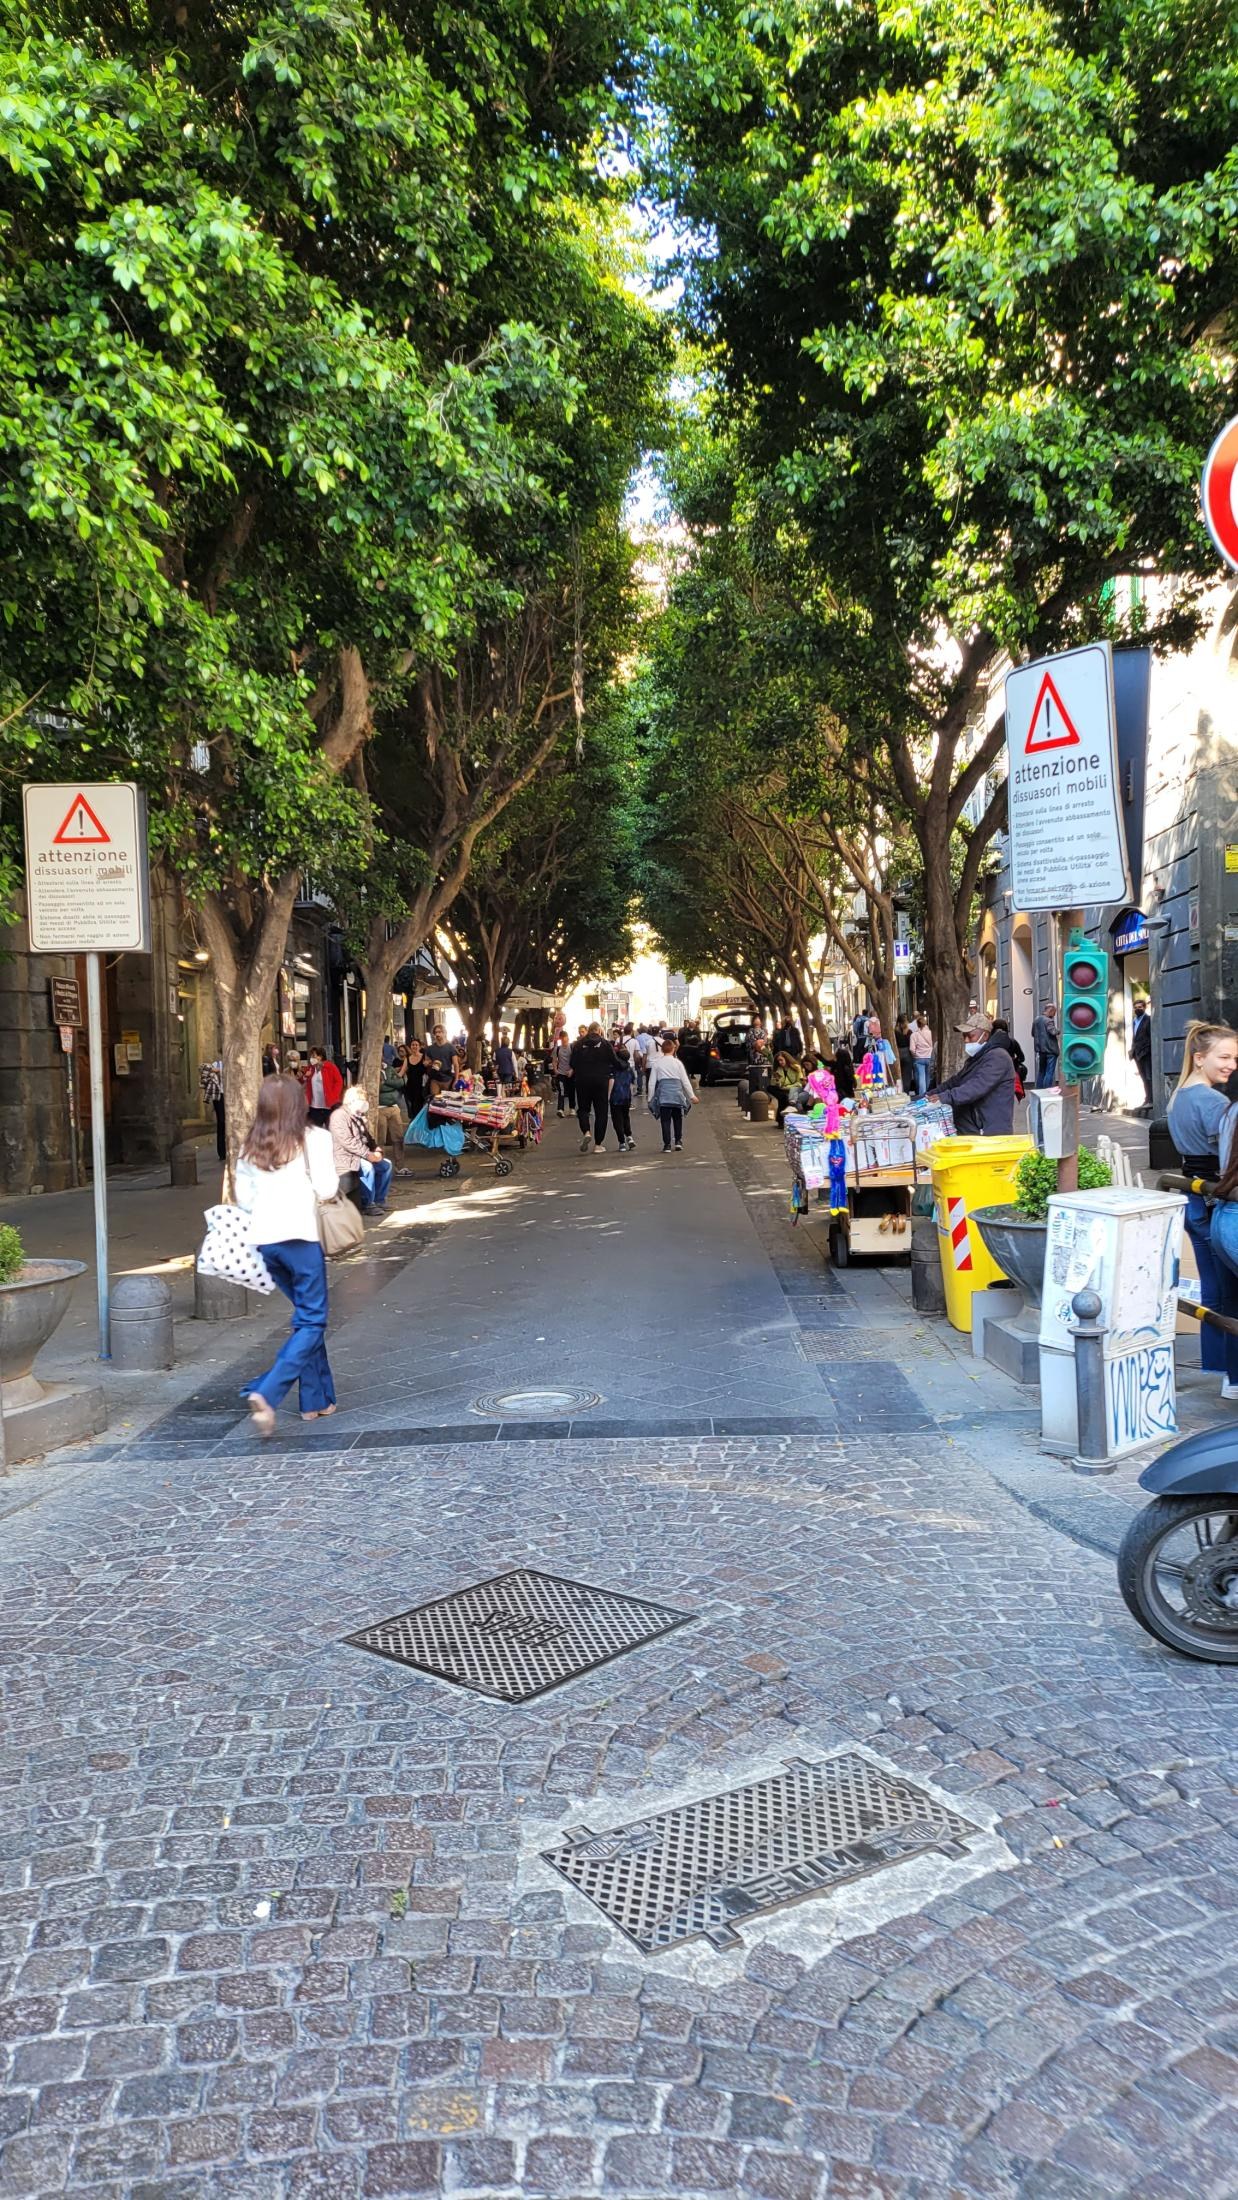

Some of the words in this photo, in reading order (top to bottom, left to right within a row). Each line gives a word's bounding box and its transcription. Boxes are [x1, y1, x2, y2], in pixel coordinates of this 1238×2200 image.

[1015, 754, 1100, 784] attenzione
[1013, 782, 1060, 804] dissuasori
[1066, 774, 1107, 794] mobili
[34, 866, 92, 875] dissuasori
[98, 865, 132, 874] mobili
[38, 849, 127, 862] attenzione
[779, 1848, 863, 1885] TIM
